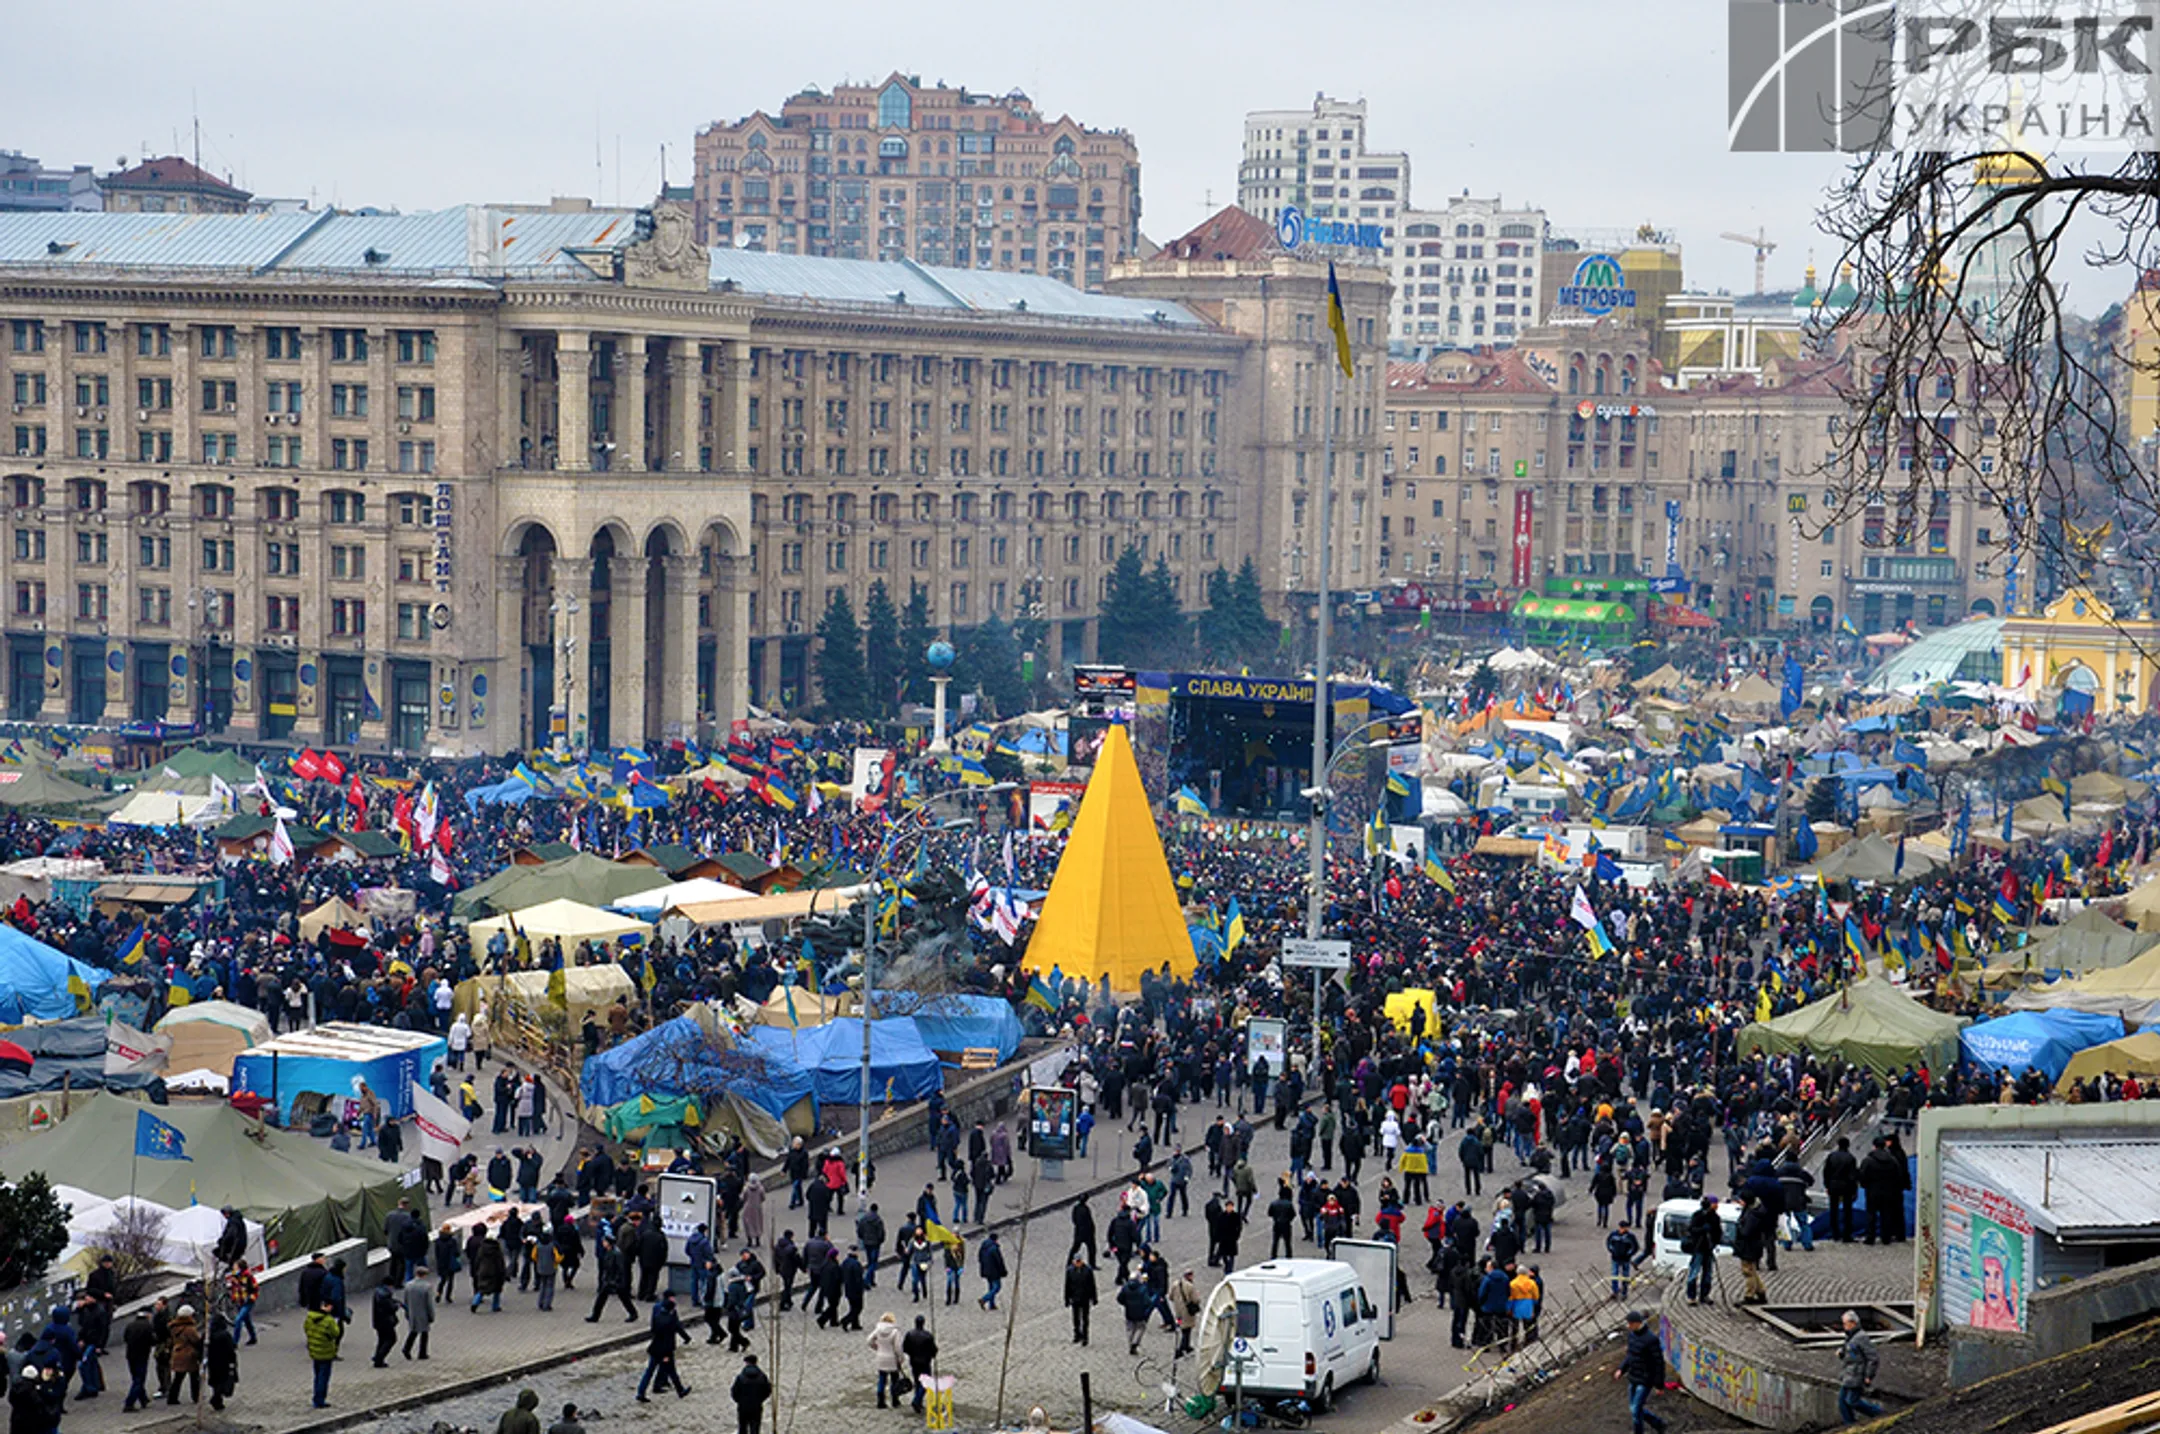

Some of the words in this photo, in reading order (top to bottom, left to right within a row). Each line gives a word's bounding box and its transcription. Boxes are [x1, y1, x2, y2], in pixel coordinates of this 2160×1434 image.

[1558, 287, 1636, 308] МЕТРОБУД
[435, 483, 451, 593] ПОШТАМТ
[1188, 679, 1245, 698] СЛАВА
